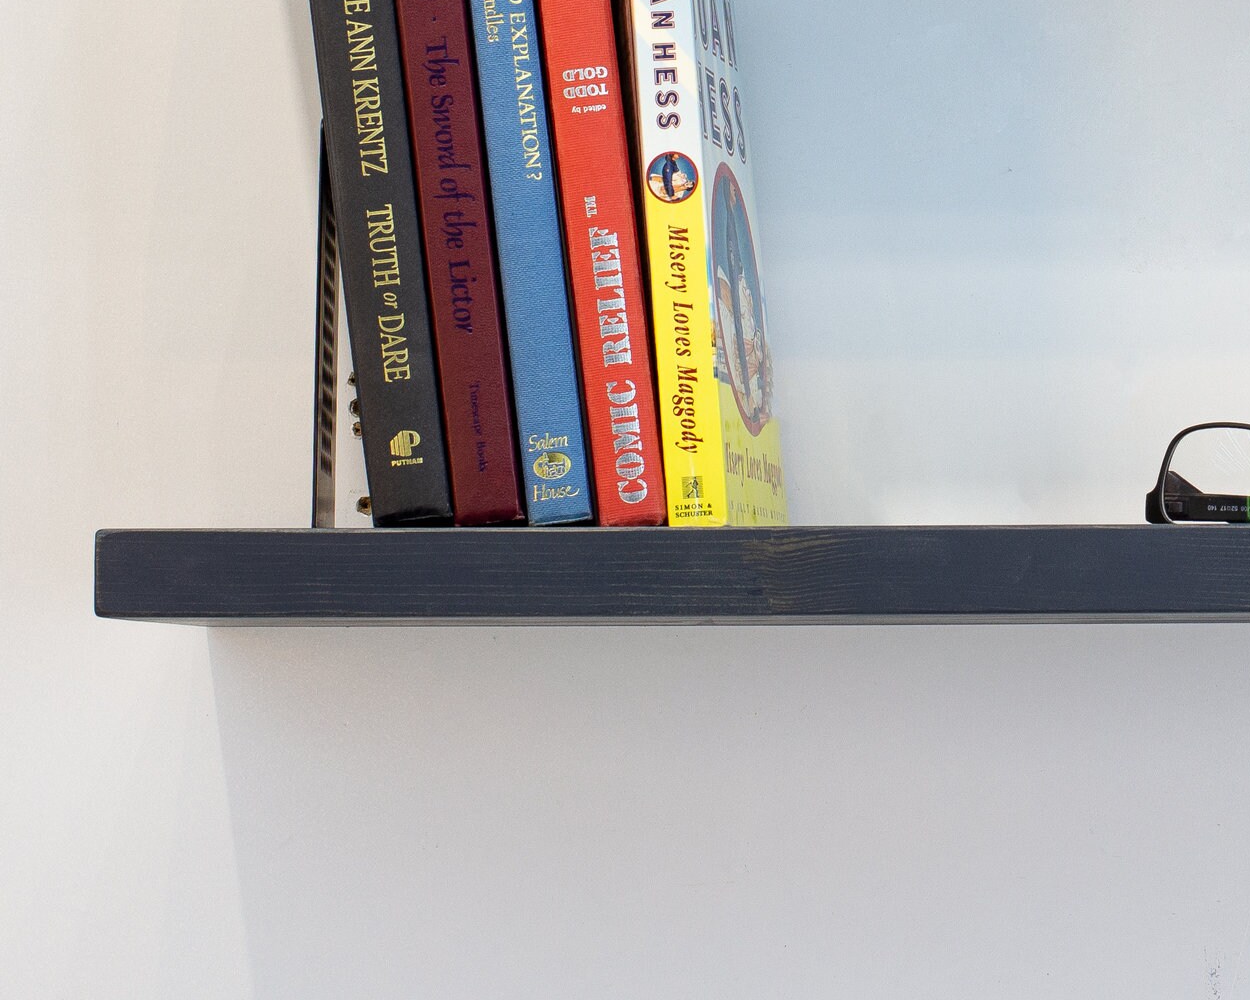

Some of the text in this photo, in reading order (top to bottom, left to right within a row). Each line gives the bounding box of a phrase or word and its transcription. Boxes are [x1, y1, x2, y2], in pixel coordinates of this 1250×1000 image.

[346, 19, 377, 72] ANN
[421, 34, 459, 88] The
[562, 66, 608, 82] GOLD
[563, 83, 608, 99] TODD
[652, 42, 681, 130] HESS
[353, 76, 389, 177] KRENTZ
[432, 95, 470, 170] Sword
[571, 104, 607, 114] edited by
[434, 178, 475, 203] of
[443, 208, 476, 250] the
[366, 203, 411, 383] TRUTH or DARE
[449, 259, 476, 335] Lictor
[589, 227, 633, 368] RELIEF
[665, 225, 704, 454] Misery Loves Maggody
[528, 432, 568, 452] Salem
[606, 379, 648, 505] COMIC
[533, 484, 580, 501] House
[675, 503, 703, 511] SIMON
